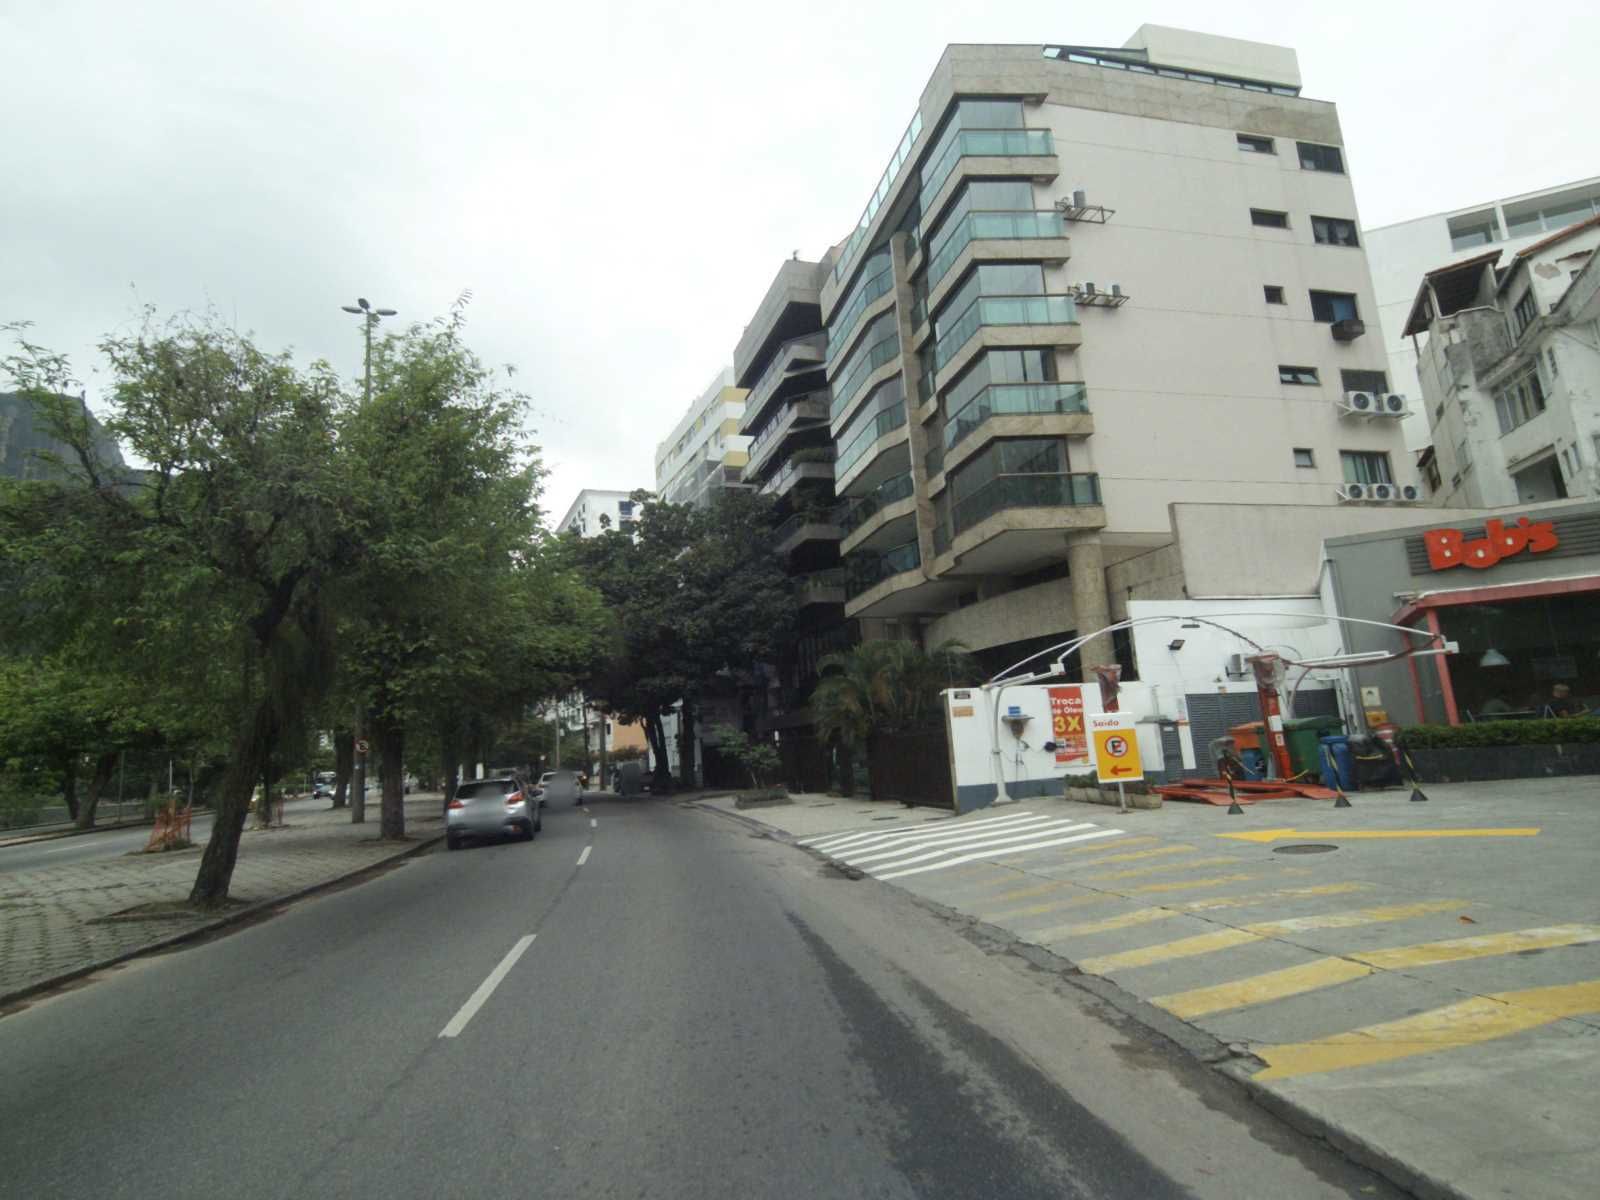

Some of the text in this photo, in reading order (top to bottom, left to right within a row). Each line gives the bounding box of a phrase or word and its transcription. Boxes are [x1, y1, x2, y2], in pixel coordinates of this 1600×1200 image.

[1424, 517, 1559, 570] Bob's
[1051, 697, 1082, 705] Troca
[1055, 716, 1082, 733] 3X
[1111, 740, 1122, 753] E
